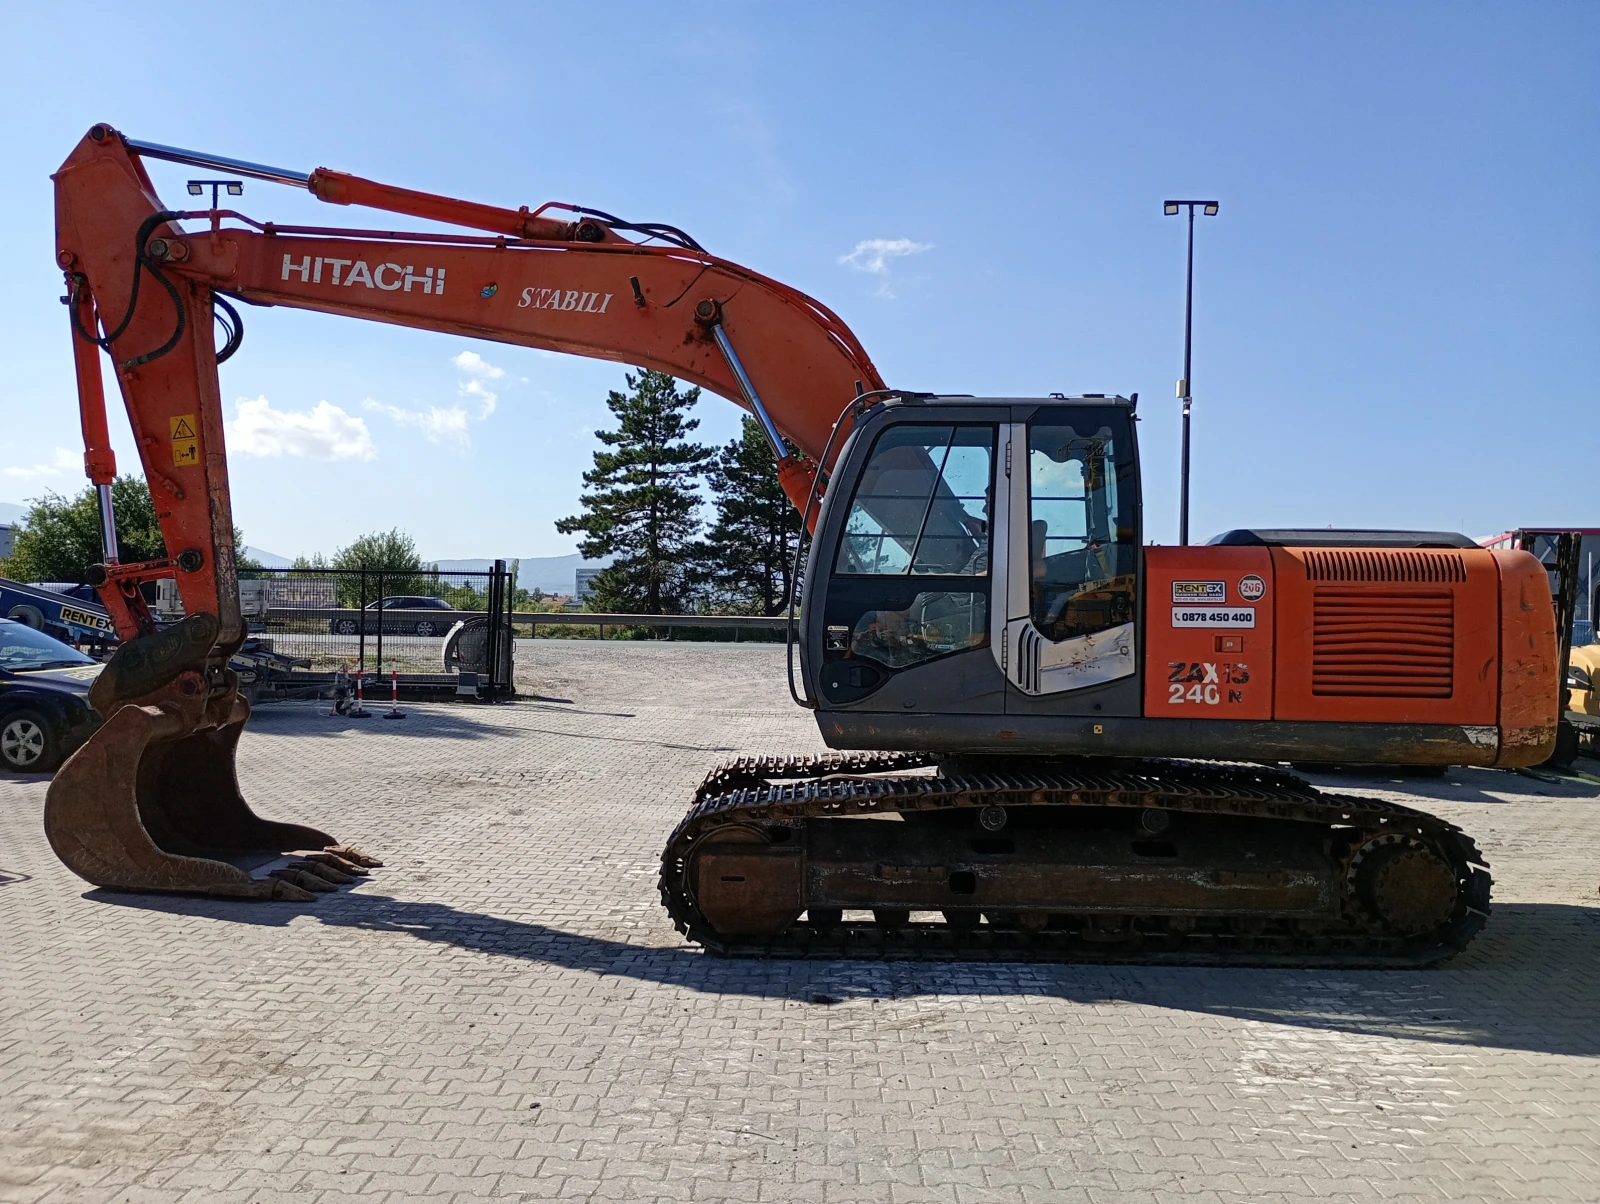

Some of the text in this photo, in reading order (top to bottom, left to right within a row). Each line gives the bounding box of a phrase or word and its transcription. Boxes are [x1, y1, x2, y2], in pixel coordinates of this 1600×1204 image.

[281, 254, 446, 295] HITACHI
[517, 287, 613, 313] STABILI
[1176, 584, 1222, 592] RENTEX
[1243, 583, 1260, 592] 206
[62, 608, 113, 630] RENTEX
[1182, 613, 1252, 622] 0878 450 400
[1168, 684, 1220, 705] 240
